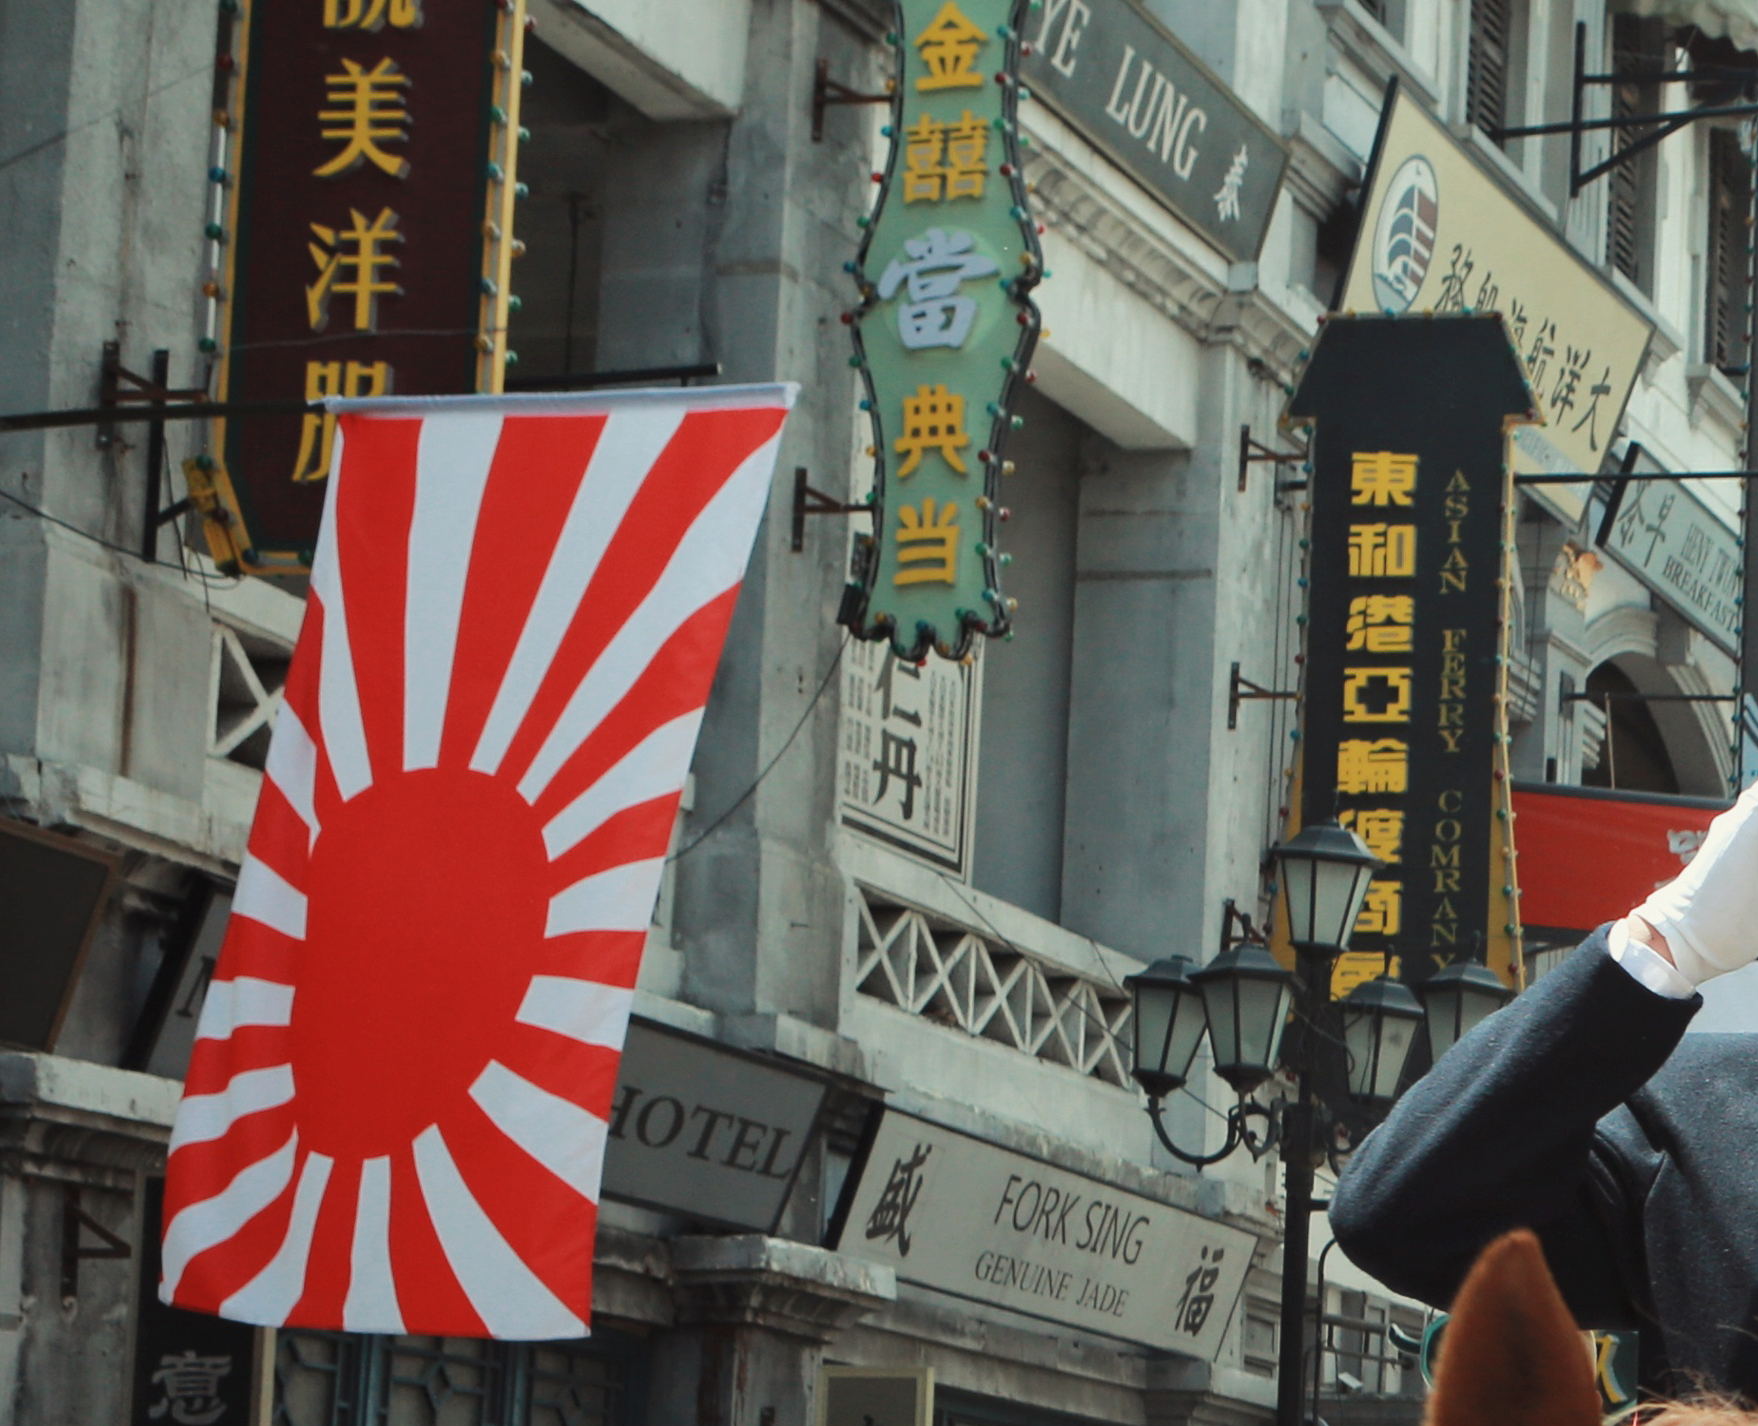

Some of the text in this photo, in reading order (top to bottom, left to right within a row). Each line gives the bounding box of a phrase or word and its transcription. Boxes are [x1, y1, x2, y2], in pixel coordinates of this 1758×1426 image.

[1105, 44, 1207, 181] LUNG
[1442, 469, 1471, 594] ASIAN
[1437, 629, 1467, 753] FERRY
[609, 1084, 793, 1180] HOTEL
[994, 1174, 1150, 1265] FORK SING
[975, 1250, 1130, 1318] GENUINE JADE
